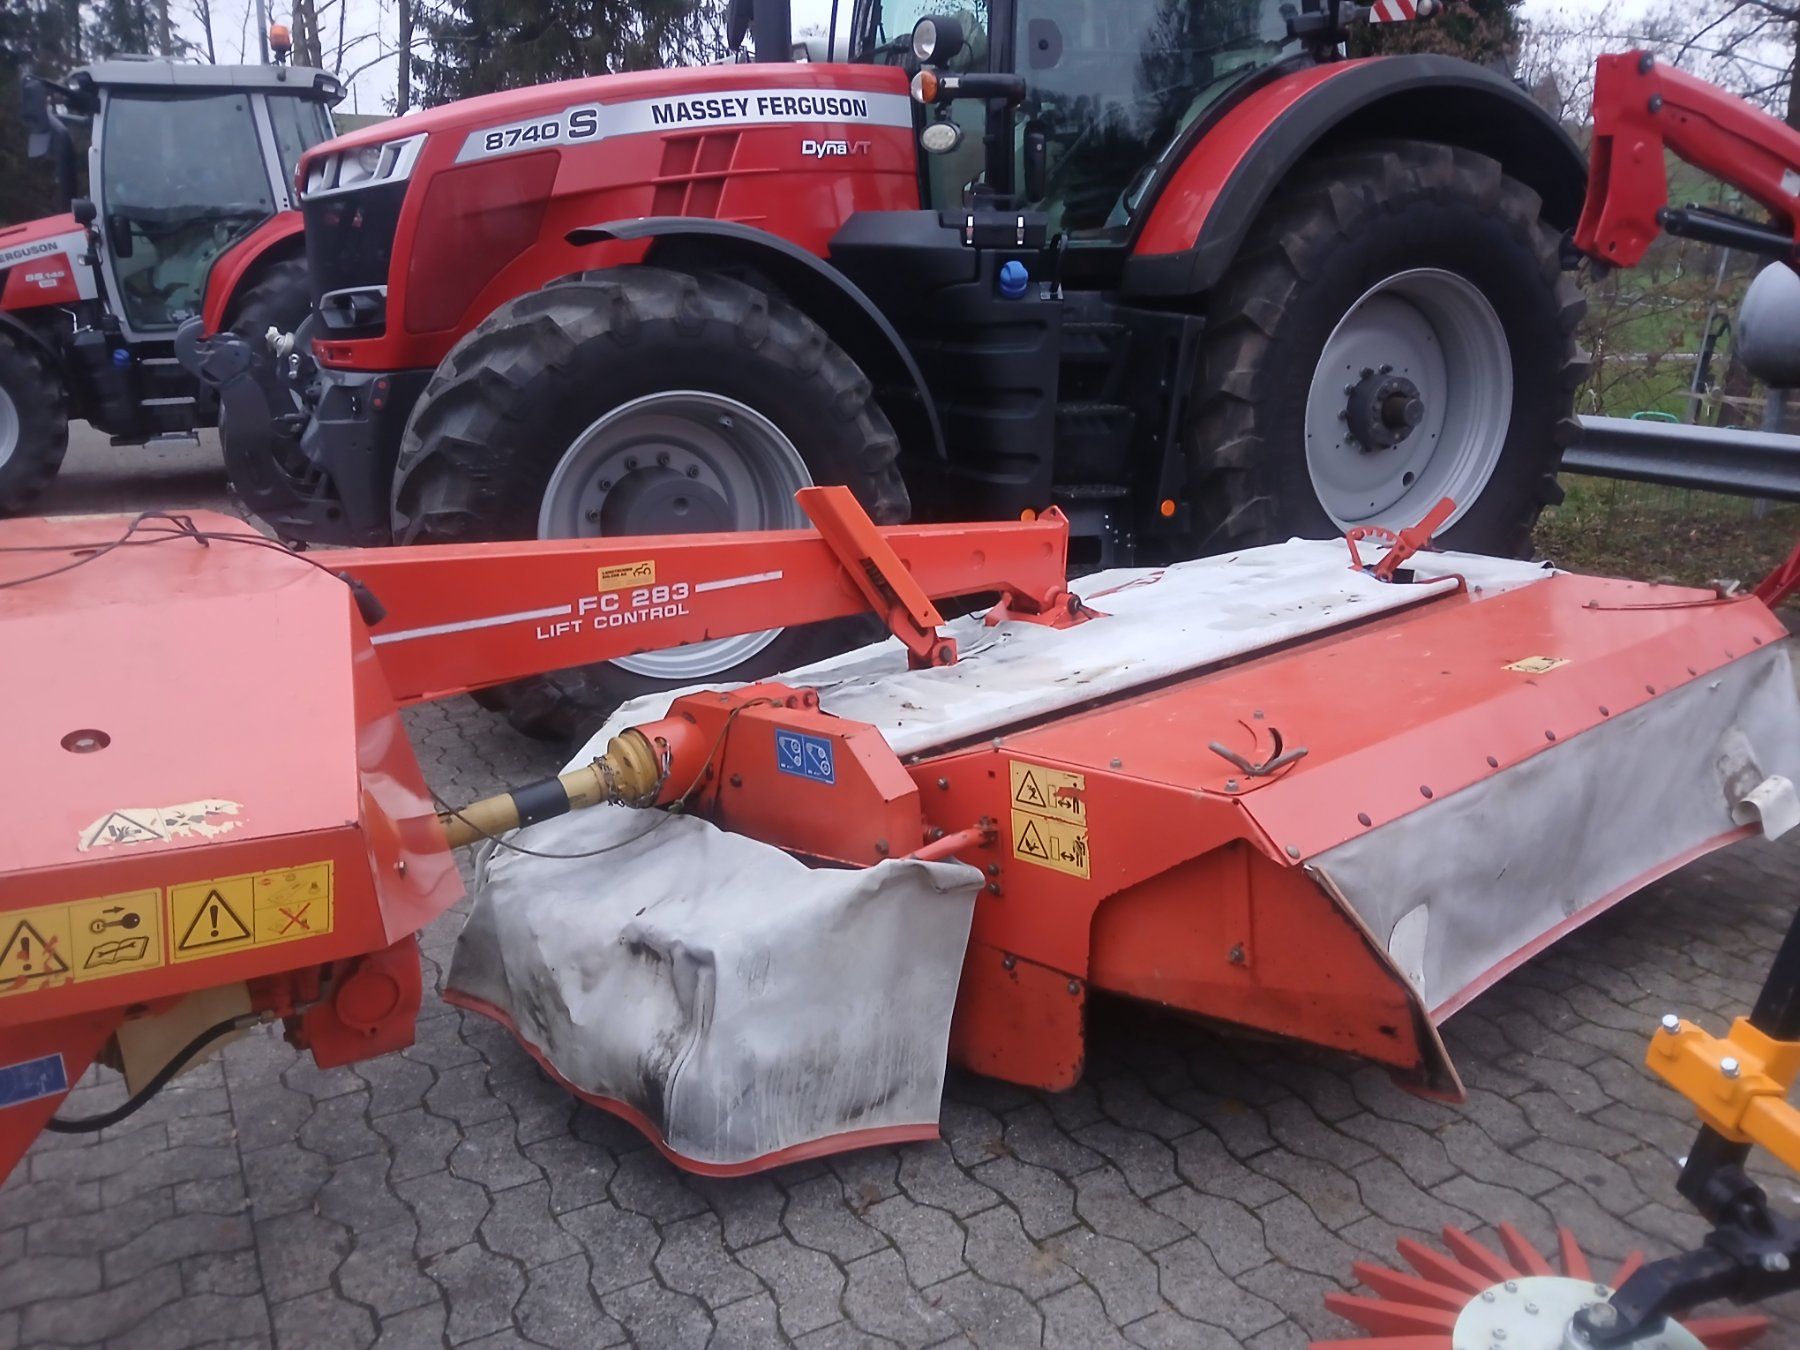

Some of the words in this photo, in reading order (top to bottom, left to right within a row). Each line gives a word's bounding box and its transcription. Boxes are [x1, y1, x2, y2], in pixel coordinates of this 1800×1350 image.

[651, 97, 749, 125] MASSEY
[756, 96, 869, 118] FERGUSON
[485, 121, 560, 151] 8740
[568, 109, 598, 139] S
[578, 592, 620, 616] FC
[631, 582, 689, 607] 283
[536, 619, 583, 640] LIFT
[593, 603, 690, 630] CONTROL
